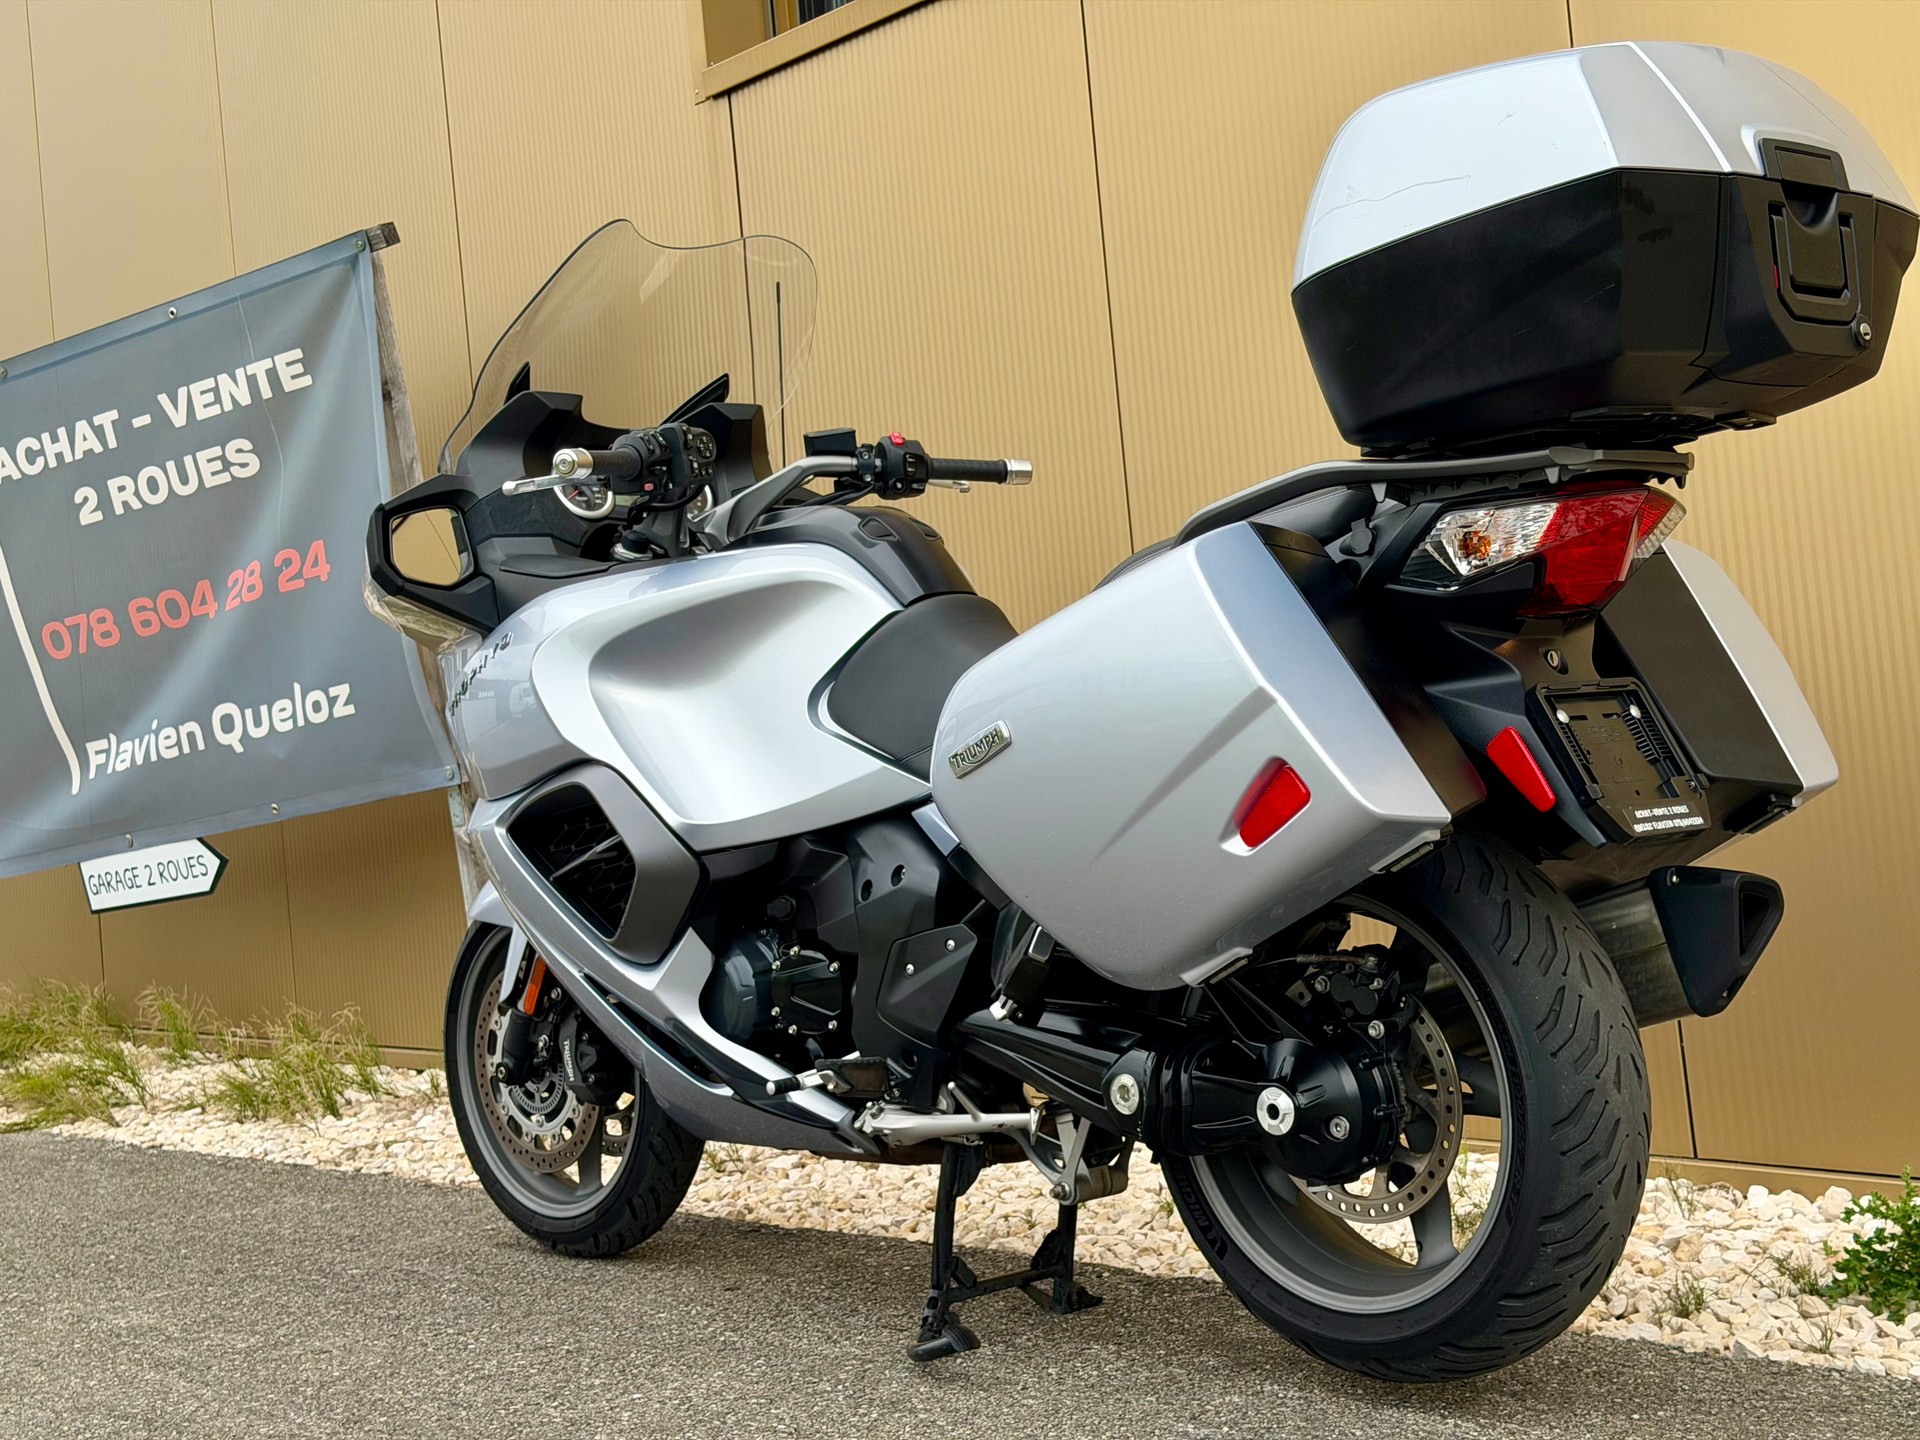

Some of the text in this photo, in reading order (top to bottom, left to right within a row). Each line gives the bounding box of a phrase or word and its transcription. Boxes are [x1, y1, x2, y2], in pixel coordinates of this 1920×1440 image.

[0, 408, 119, 485] ACHAT
[156, 347, 313, 429] VENTE
[73, 438, 261, 526] 2 ROUES
[41, 539, 331, 660] 078 604 28 24
[85, 681, 356, 780] Flavien Queloz
[949, 727, 1001, 770] TRIUMPH
[88, 854, 209, 896] GARAGE 2 ROUES
